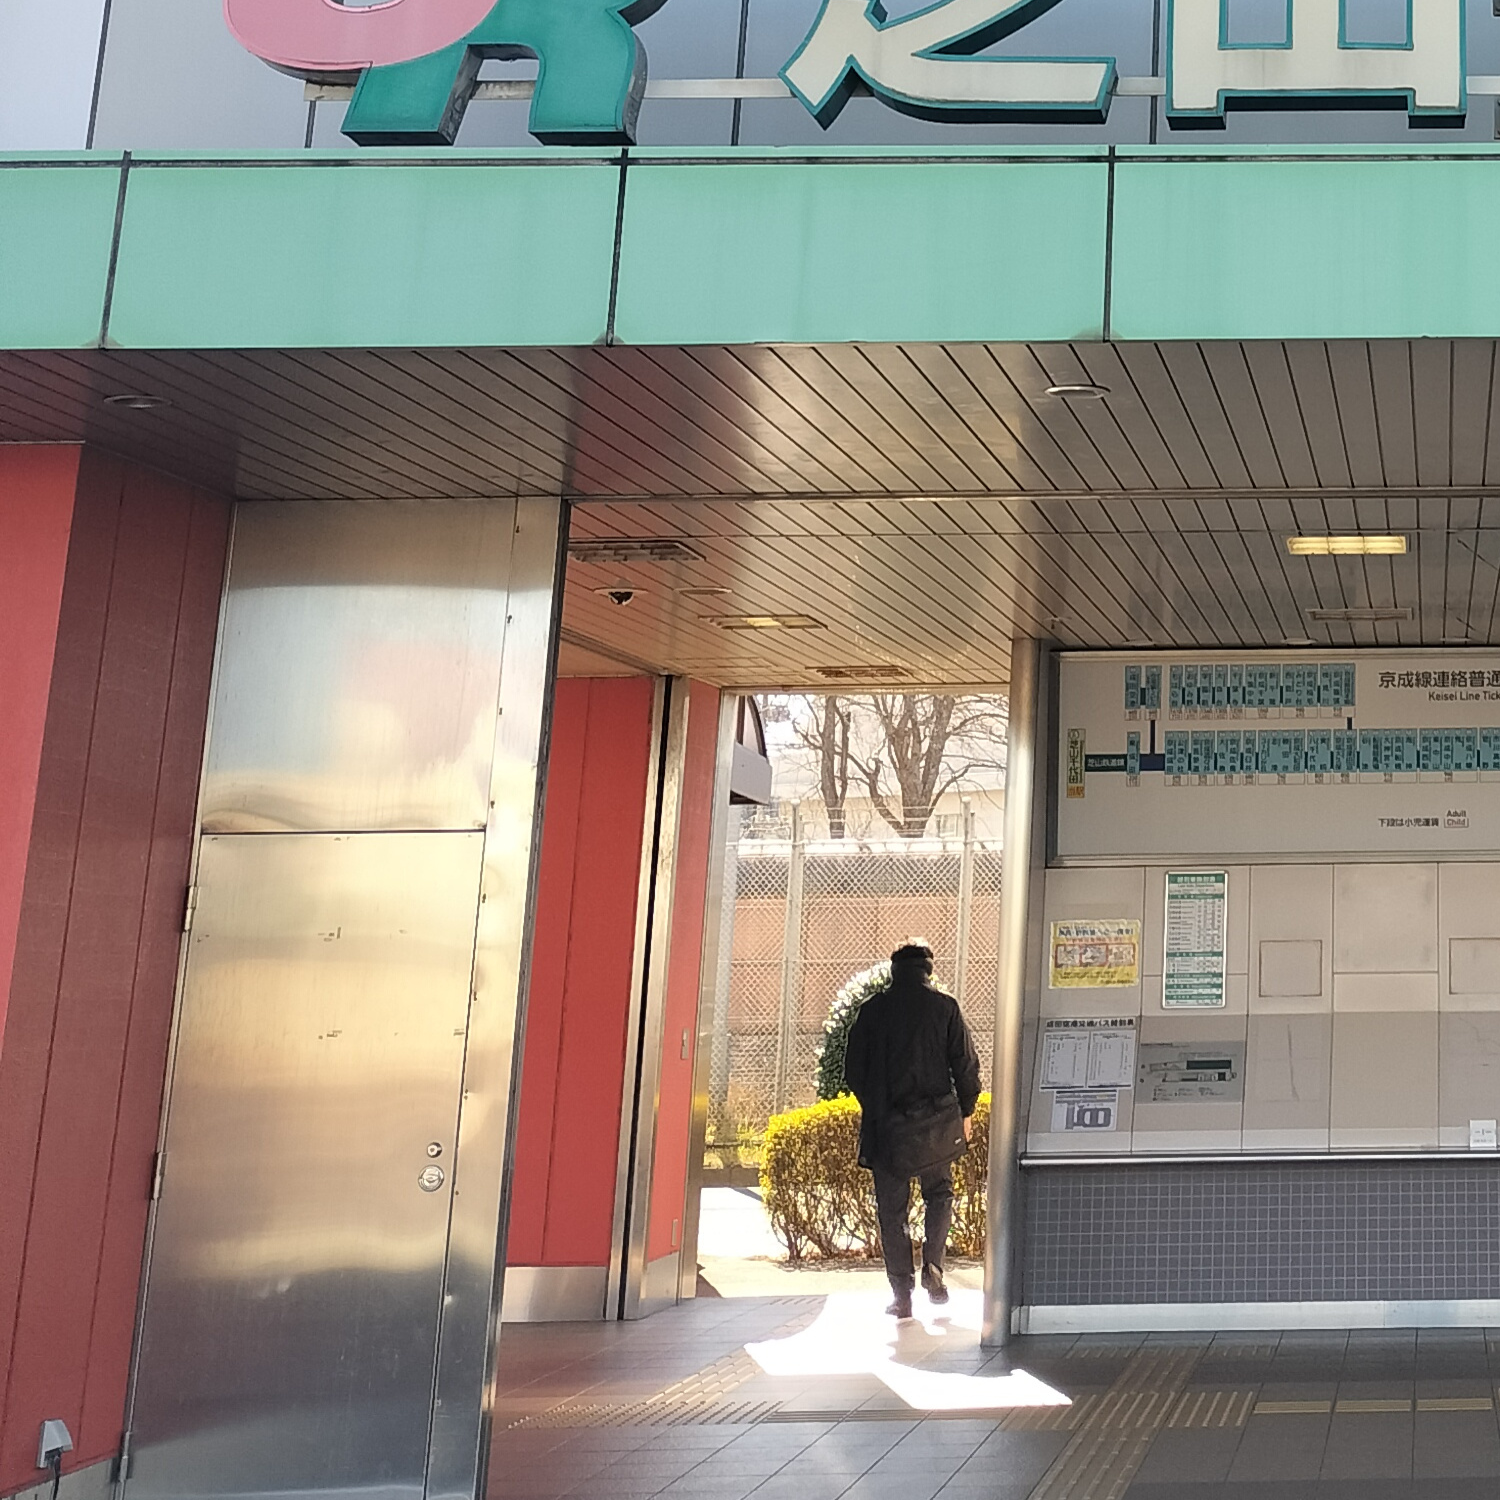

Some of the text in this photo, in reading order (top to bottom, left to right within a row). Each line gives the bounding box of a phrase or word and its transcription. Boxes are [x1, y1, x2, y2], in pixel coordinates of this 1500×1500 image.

[1428, 690, 1457, 701] Keisei
[1459, 690, 1481, 700] Line
[1446, 809, 1466, 817] Adult
